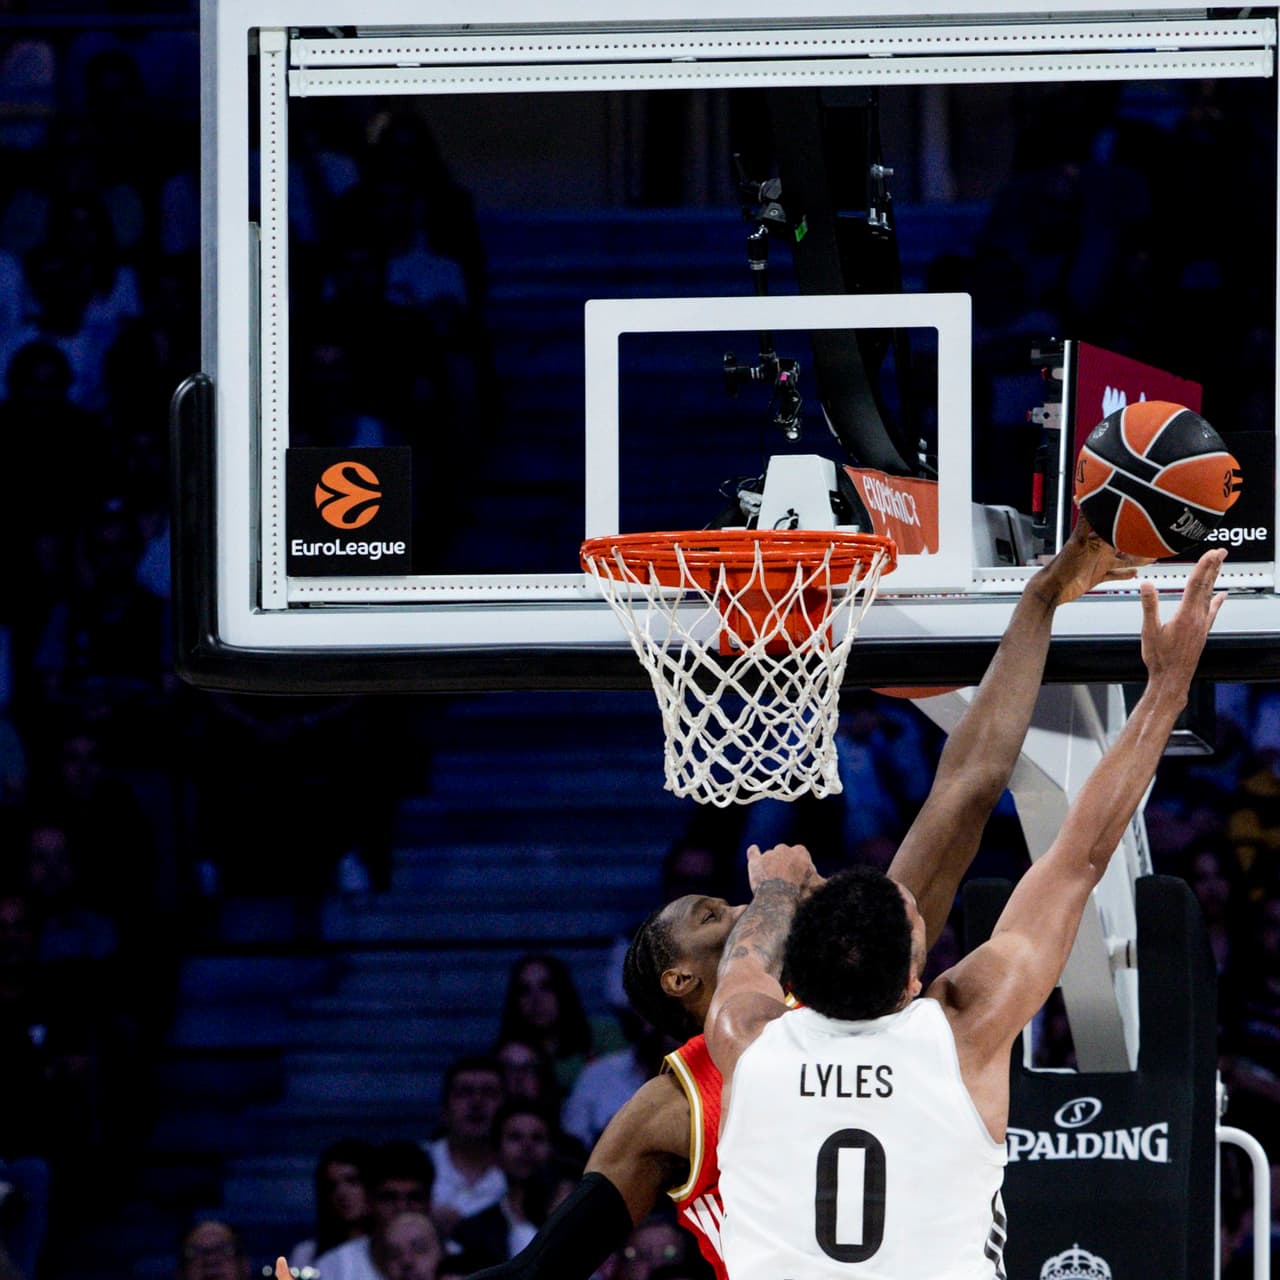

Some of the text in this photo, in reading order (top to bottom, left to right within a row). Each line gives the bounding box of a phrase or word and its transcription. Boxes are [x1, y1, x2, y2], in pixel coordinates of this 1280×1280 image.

[291, 538, 406, 560] EuroLeague
[1204, 526, 1268, 546] eague
[800, 1063, 894, 1098] LYLES
[1007, 1122, 1170, 1164] PALDING
[815, 1128, 887, 1264] 0
